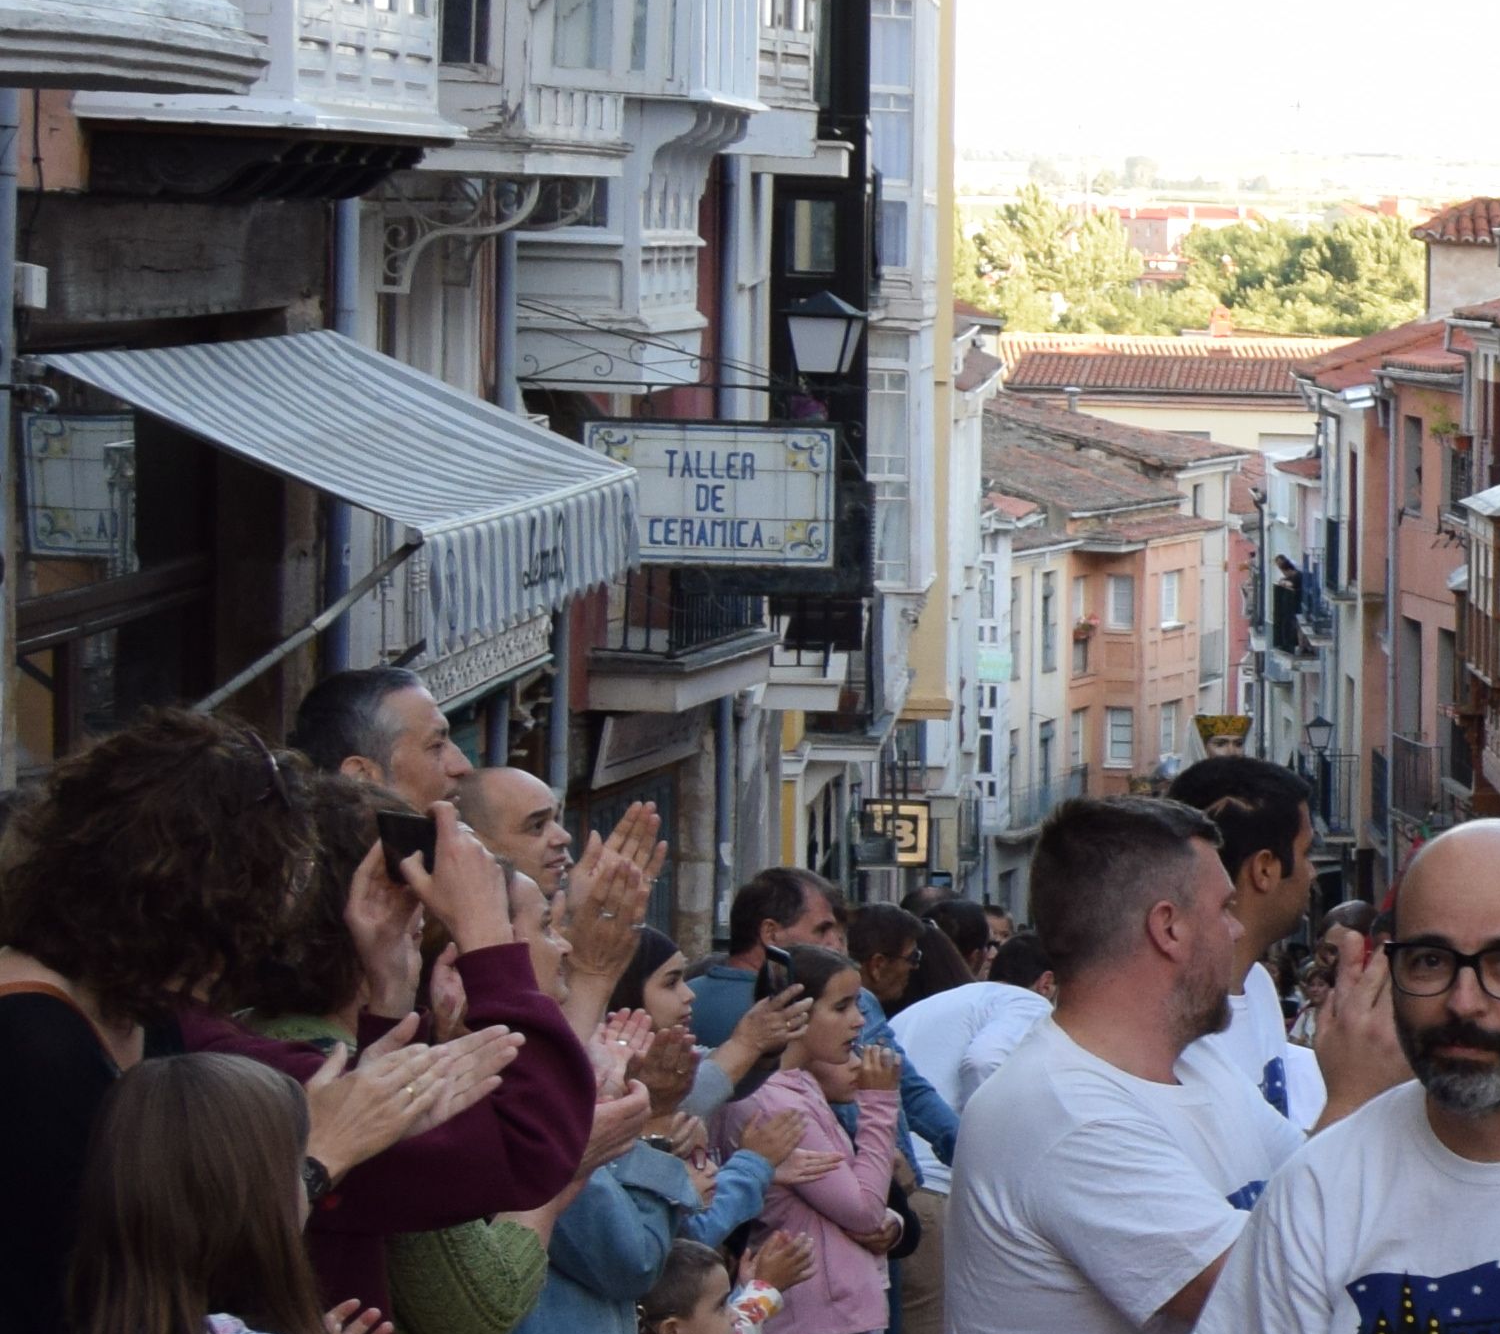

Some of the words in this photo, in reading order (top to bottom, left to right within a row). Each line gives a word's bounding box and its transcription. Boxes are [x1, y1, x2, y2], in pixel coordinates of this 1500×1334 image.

[665, 449, 755, 480] TALLER
[696, 483, 726, 513] DE
[649, 518, 764, 548] CERAMICA
